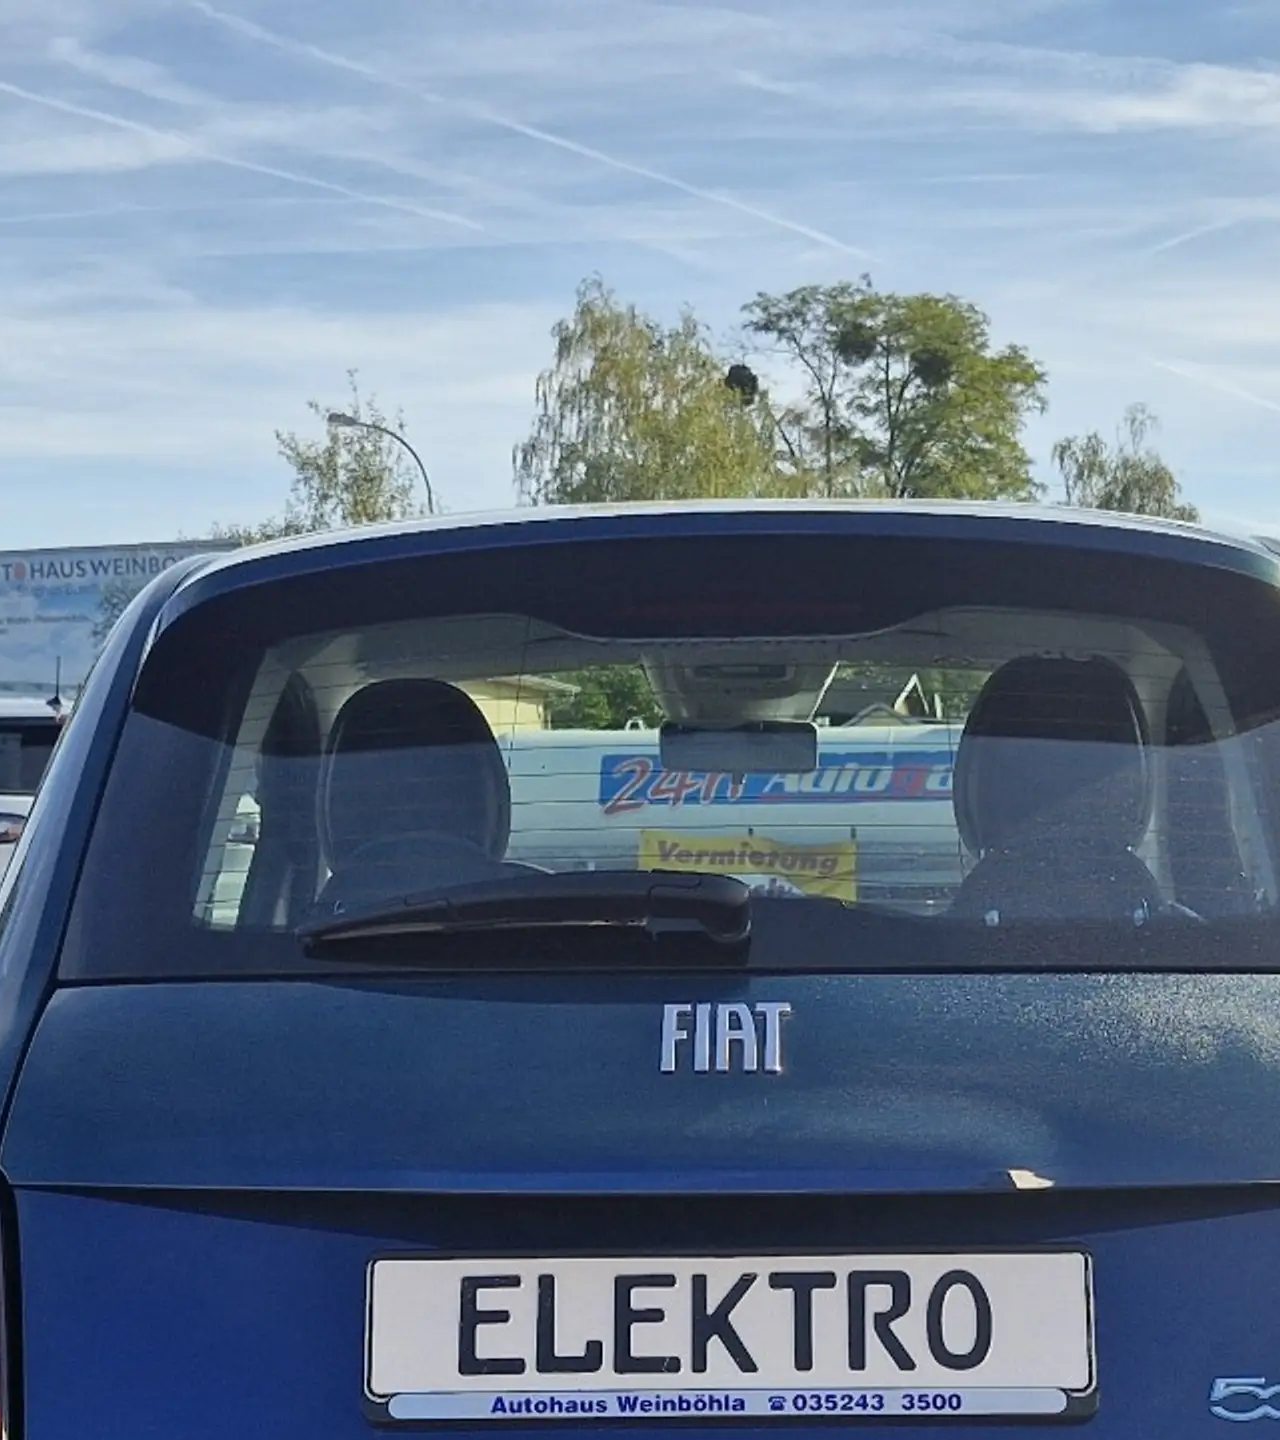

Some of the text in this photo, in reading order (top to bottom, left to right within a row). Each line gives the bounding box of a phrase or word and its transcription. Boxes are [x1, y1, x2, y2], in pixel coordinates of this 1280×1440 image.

[657, 840, 839, 875] Vermietung
[660, 1002, 791, 1073] FIAT
[458, 1269, 993, 1375] ELEKTRO
[490, 1393, 963, 1414] Autohaus Weinböhla 035243 3500
